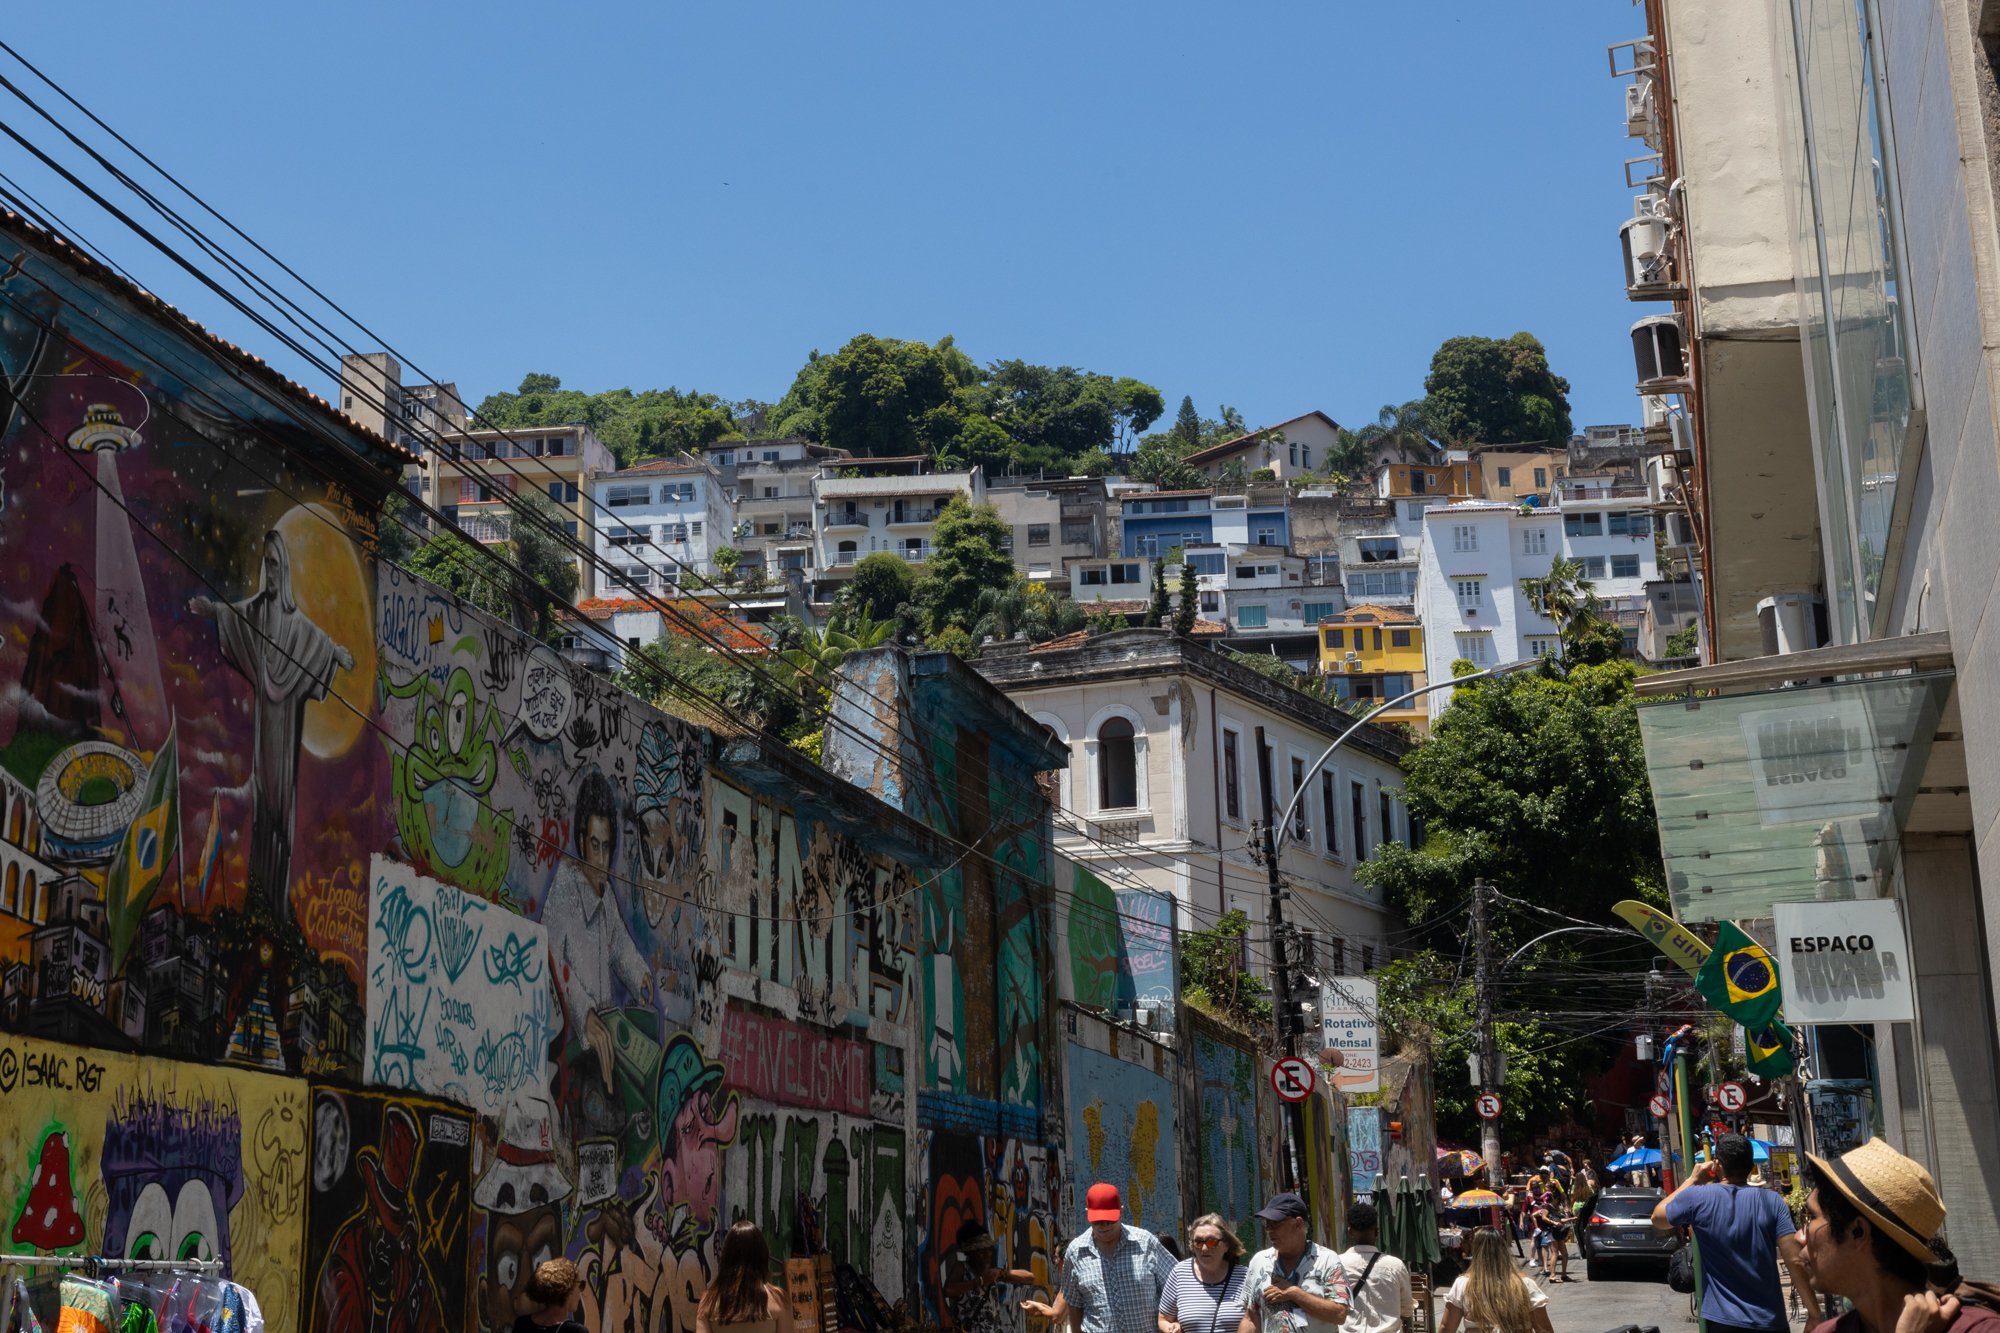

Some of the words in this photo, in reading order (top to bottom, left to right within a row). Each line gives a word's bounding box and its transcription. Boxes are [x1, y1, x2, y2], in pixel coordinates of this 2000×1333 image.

[1790, 935, 1874, 955] ESPAÇO
[1324, 1018, 1375, 1029] Rotativo
[1346, 1030, 1354, 1038] e
[1328, 1037, 1372, 1048] Mensal
